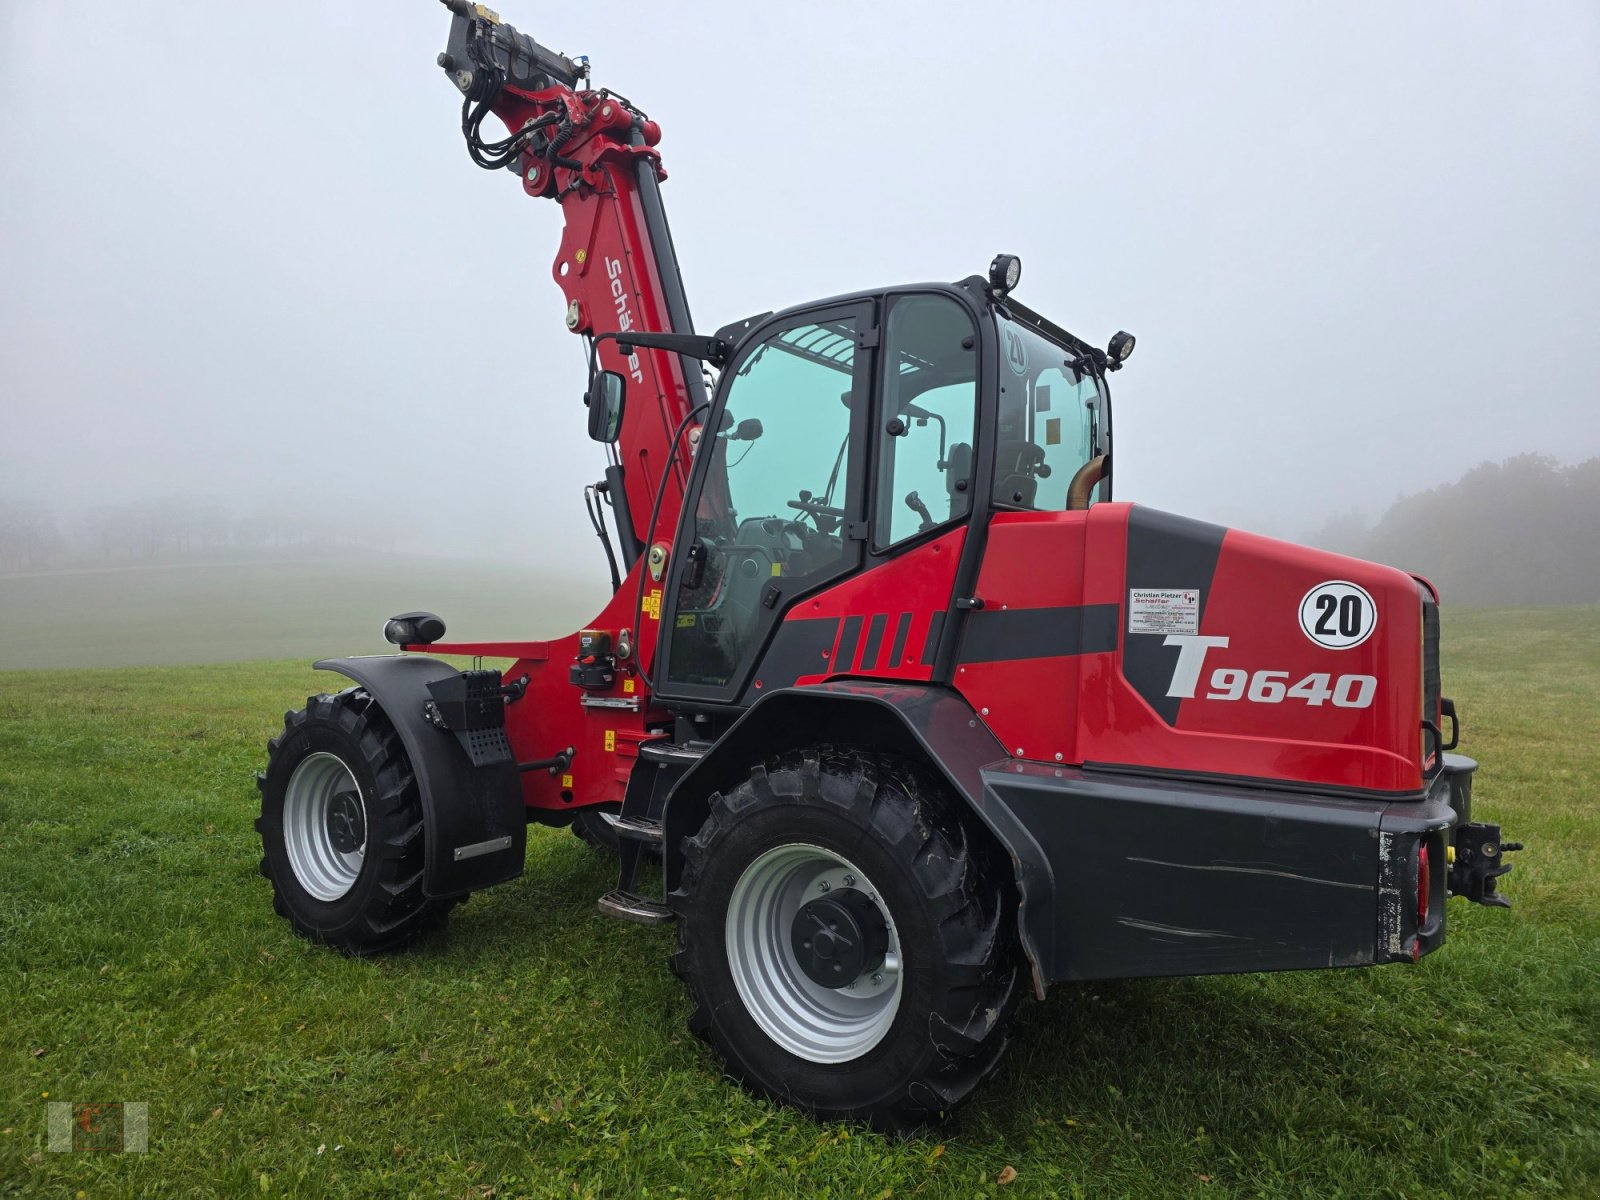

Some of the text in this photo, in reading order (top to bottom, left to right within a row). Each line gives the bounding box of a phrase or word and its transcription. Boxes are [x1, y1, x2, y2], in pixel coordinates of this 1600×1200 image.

[605, 256, 644, 385] Schäer
[1007, 331, 1024, 366] 20
[1314, 594, 1363, 637] 20
